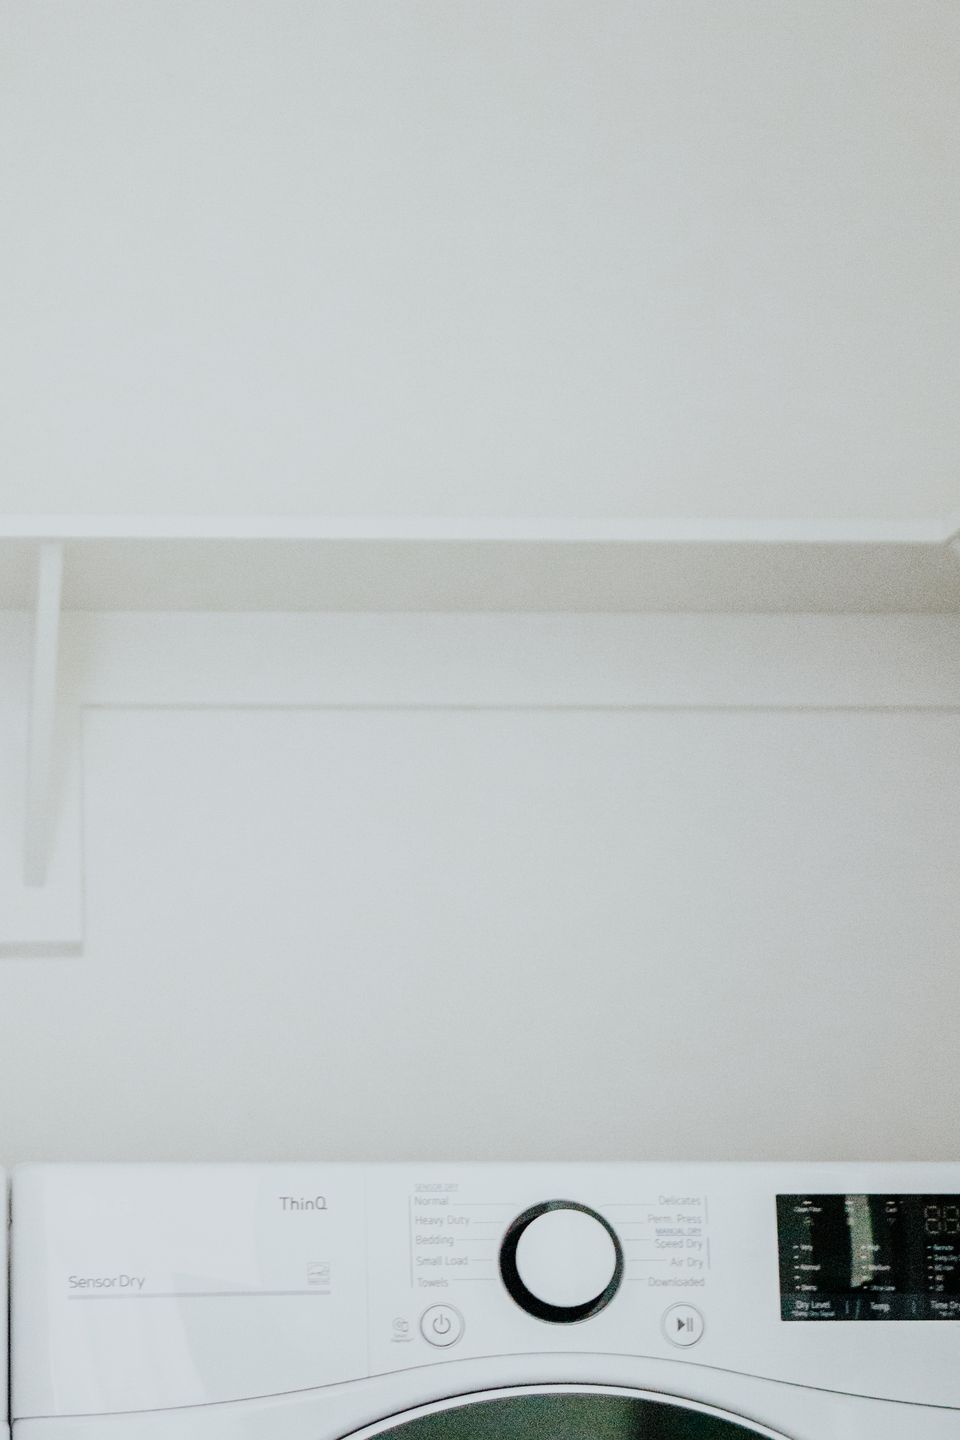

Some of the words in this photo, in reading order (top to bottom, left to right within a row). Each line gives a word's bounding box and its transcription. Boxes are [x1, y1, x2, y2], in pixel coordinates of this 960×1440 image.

[278, 1196, 328, 1210] ThinQ
[415, 1196, 449, 1206] Normal
[658, 1195, 702, 1206] Delicates
[415, 1216, 443, 1227] Heavy
[447, 1215, 470, 1226] Duty
[677, 1214, 703, 1224] Press
[415, 1235, 454, 1247] Bedding
[655, 1239, 684, 1250] Speed
[686, 1239, 703, 1250] Dry
[416, 1256, 442, 1266] Small
[445, 1256, 469, 1266] Load
[670, 1258, 683, 1267] Air
[687, 1257, 704, 1270] Dry
[415, 1277, 449, 1288] Towels
[648, 1276, 705, 1287] Downloaded
[795, 1301, 809, 1311] Dry
[811, 1301, 831, 1309] Level
